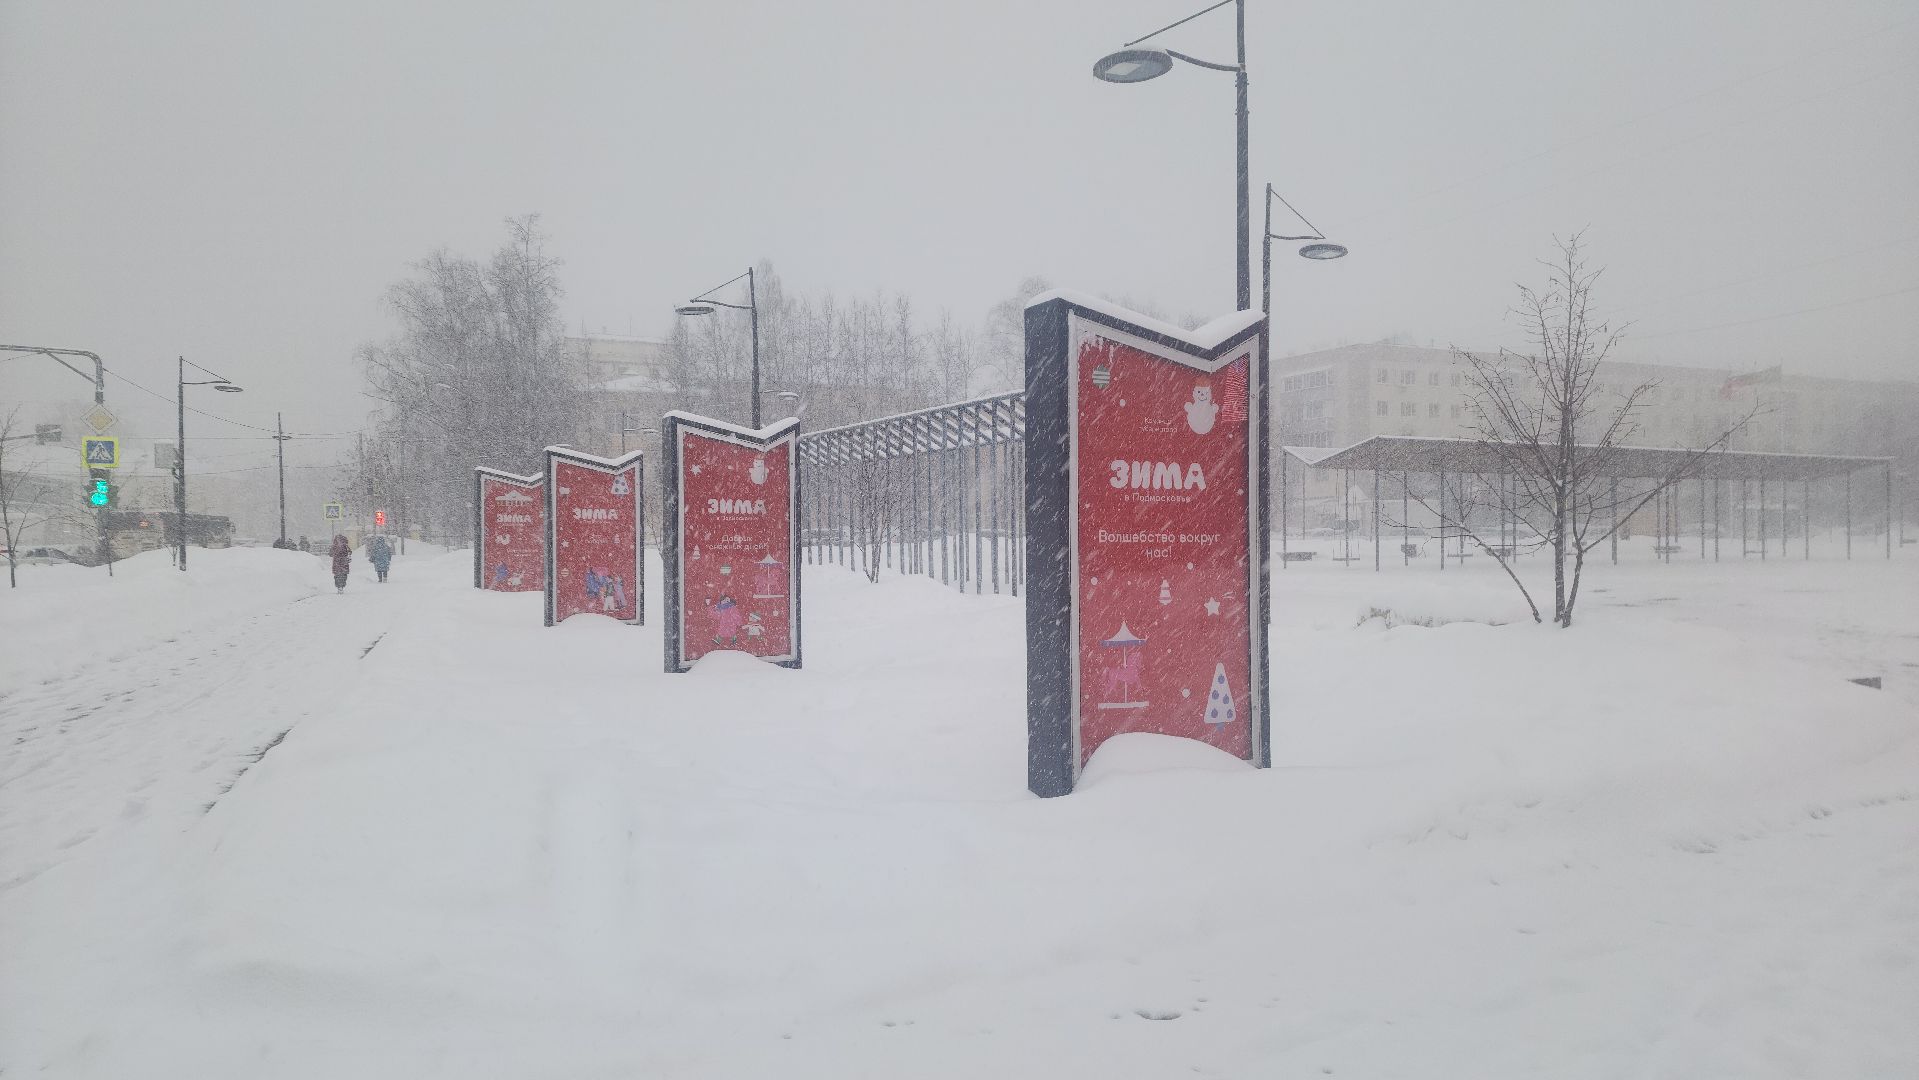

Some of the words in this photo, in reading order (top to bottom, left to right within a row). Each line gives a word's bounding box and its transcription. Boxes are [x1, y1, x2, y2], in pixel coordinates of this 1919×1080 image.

[1110, 460, 1207, 491] ЗИМА
[1132, 493, 1192, 503] Подмосковье
[708, 498, 767, 515] ЗИМА
[496, 513, 532, 523] ЗИМА
[573, 508, 619, 520] ЗИМА
[1099, 530, 1176, 543] Волшебство
[1180, 534, 1221, 545] вокруг
[1146, 546, 1173, 558] нас!
